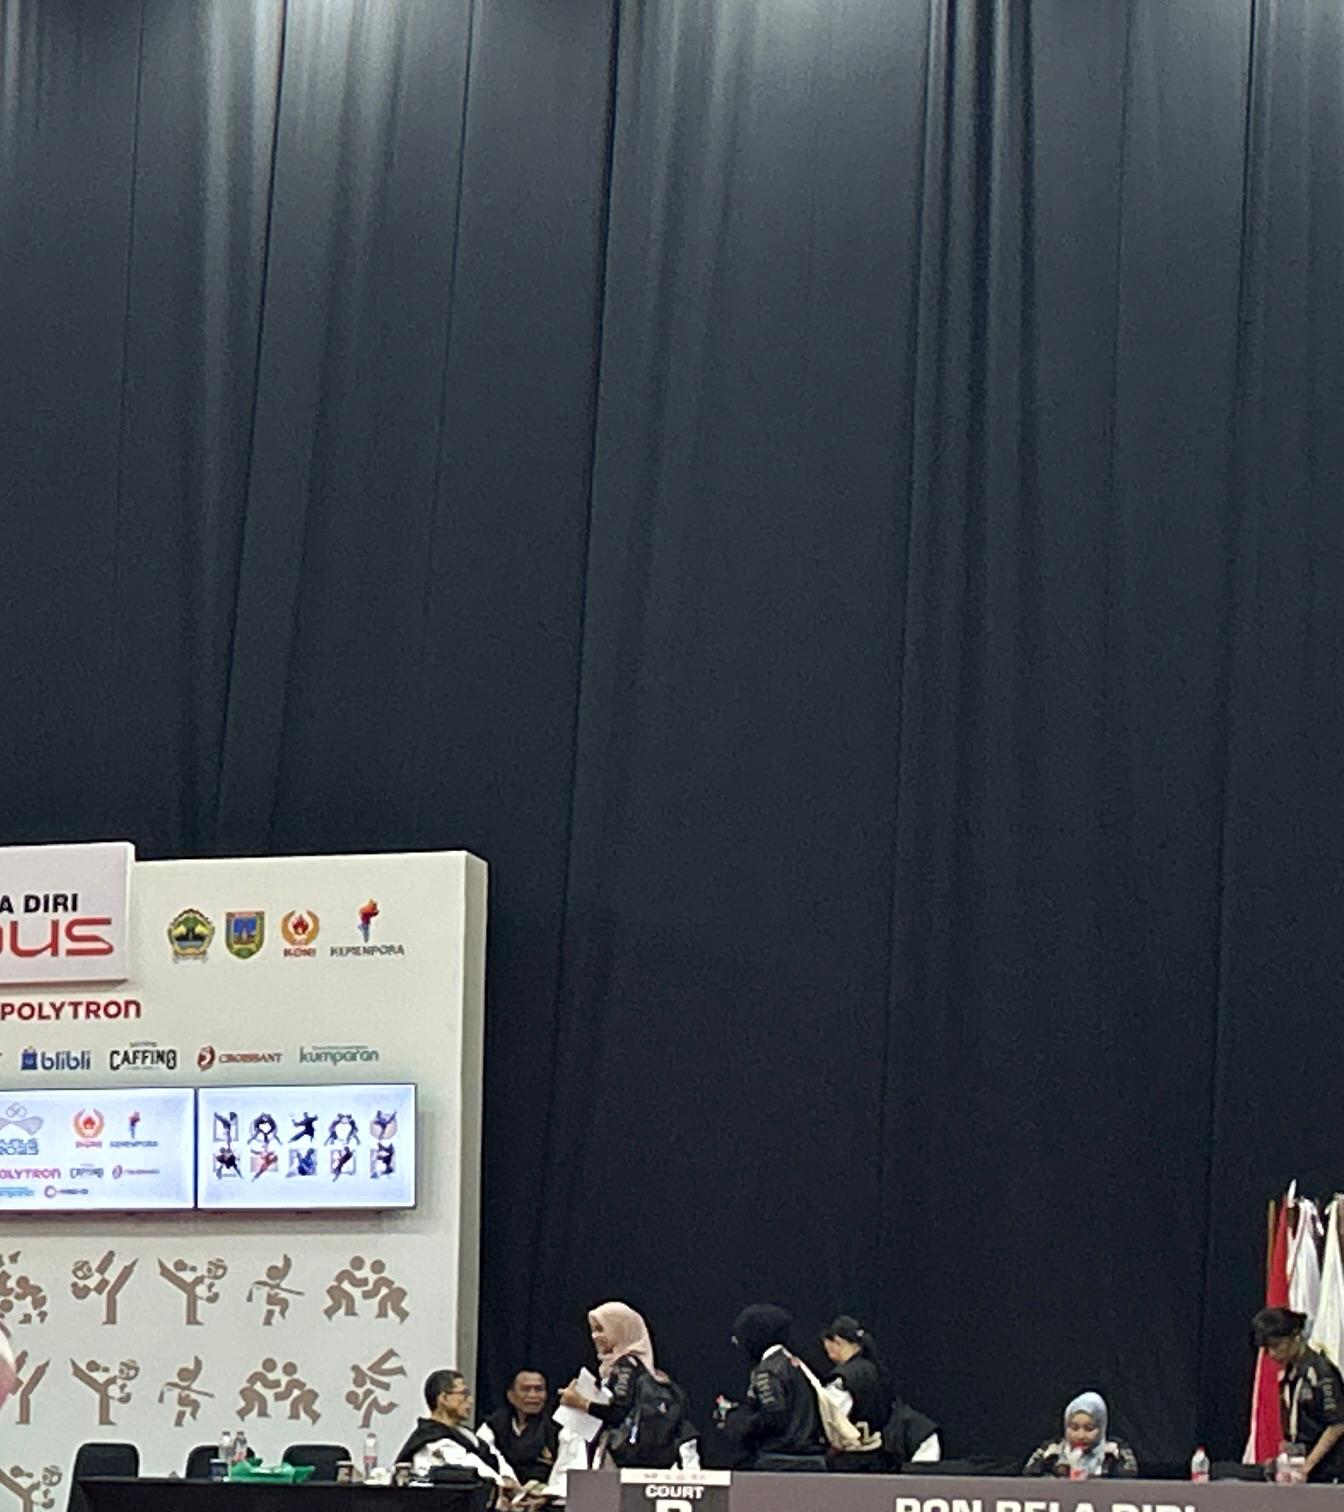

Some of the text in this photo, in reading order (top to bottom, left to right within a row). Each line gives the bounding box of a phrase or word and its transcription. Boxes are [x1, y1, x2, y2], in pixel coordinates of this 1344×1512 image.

[24, 893, 78, 913] DIRI
[0, 1000, 142, 1022] POLYTRON
[41, 1050, 91, 1071] blibli
[299, 1046, 379, 1066] kumparan
[644, 1484, 705, 1499] COURT
